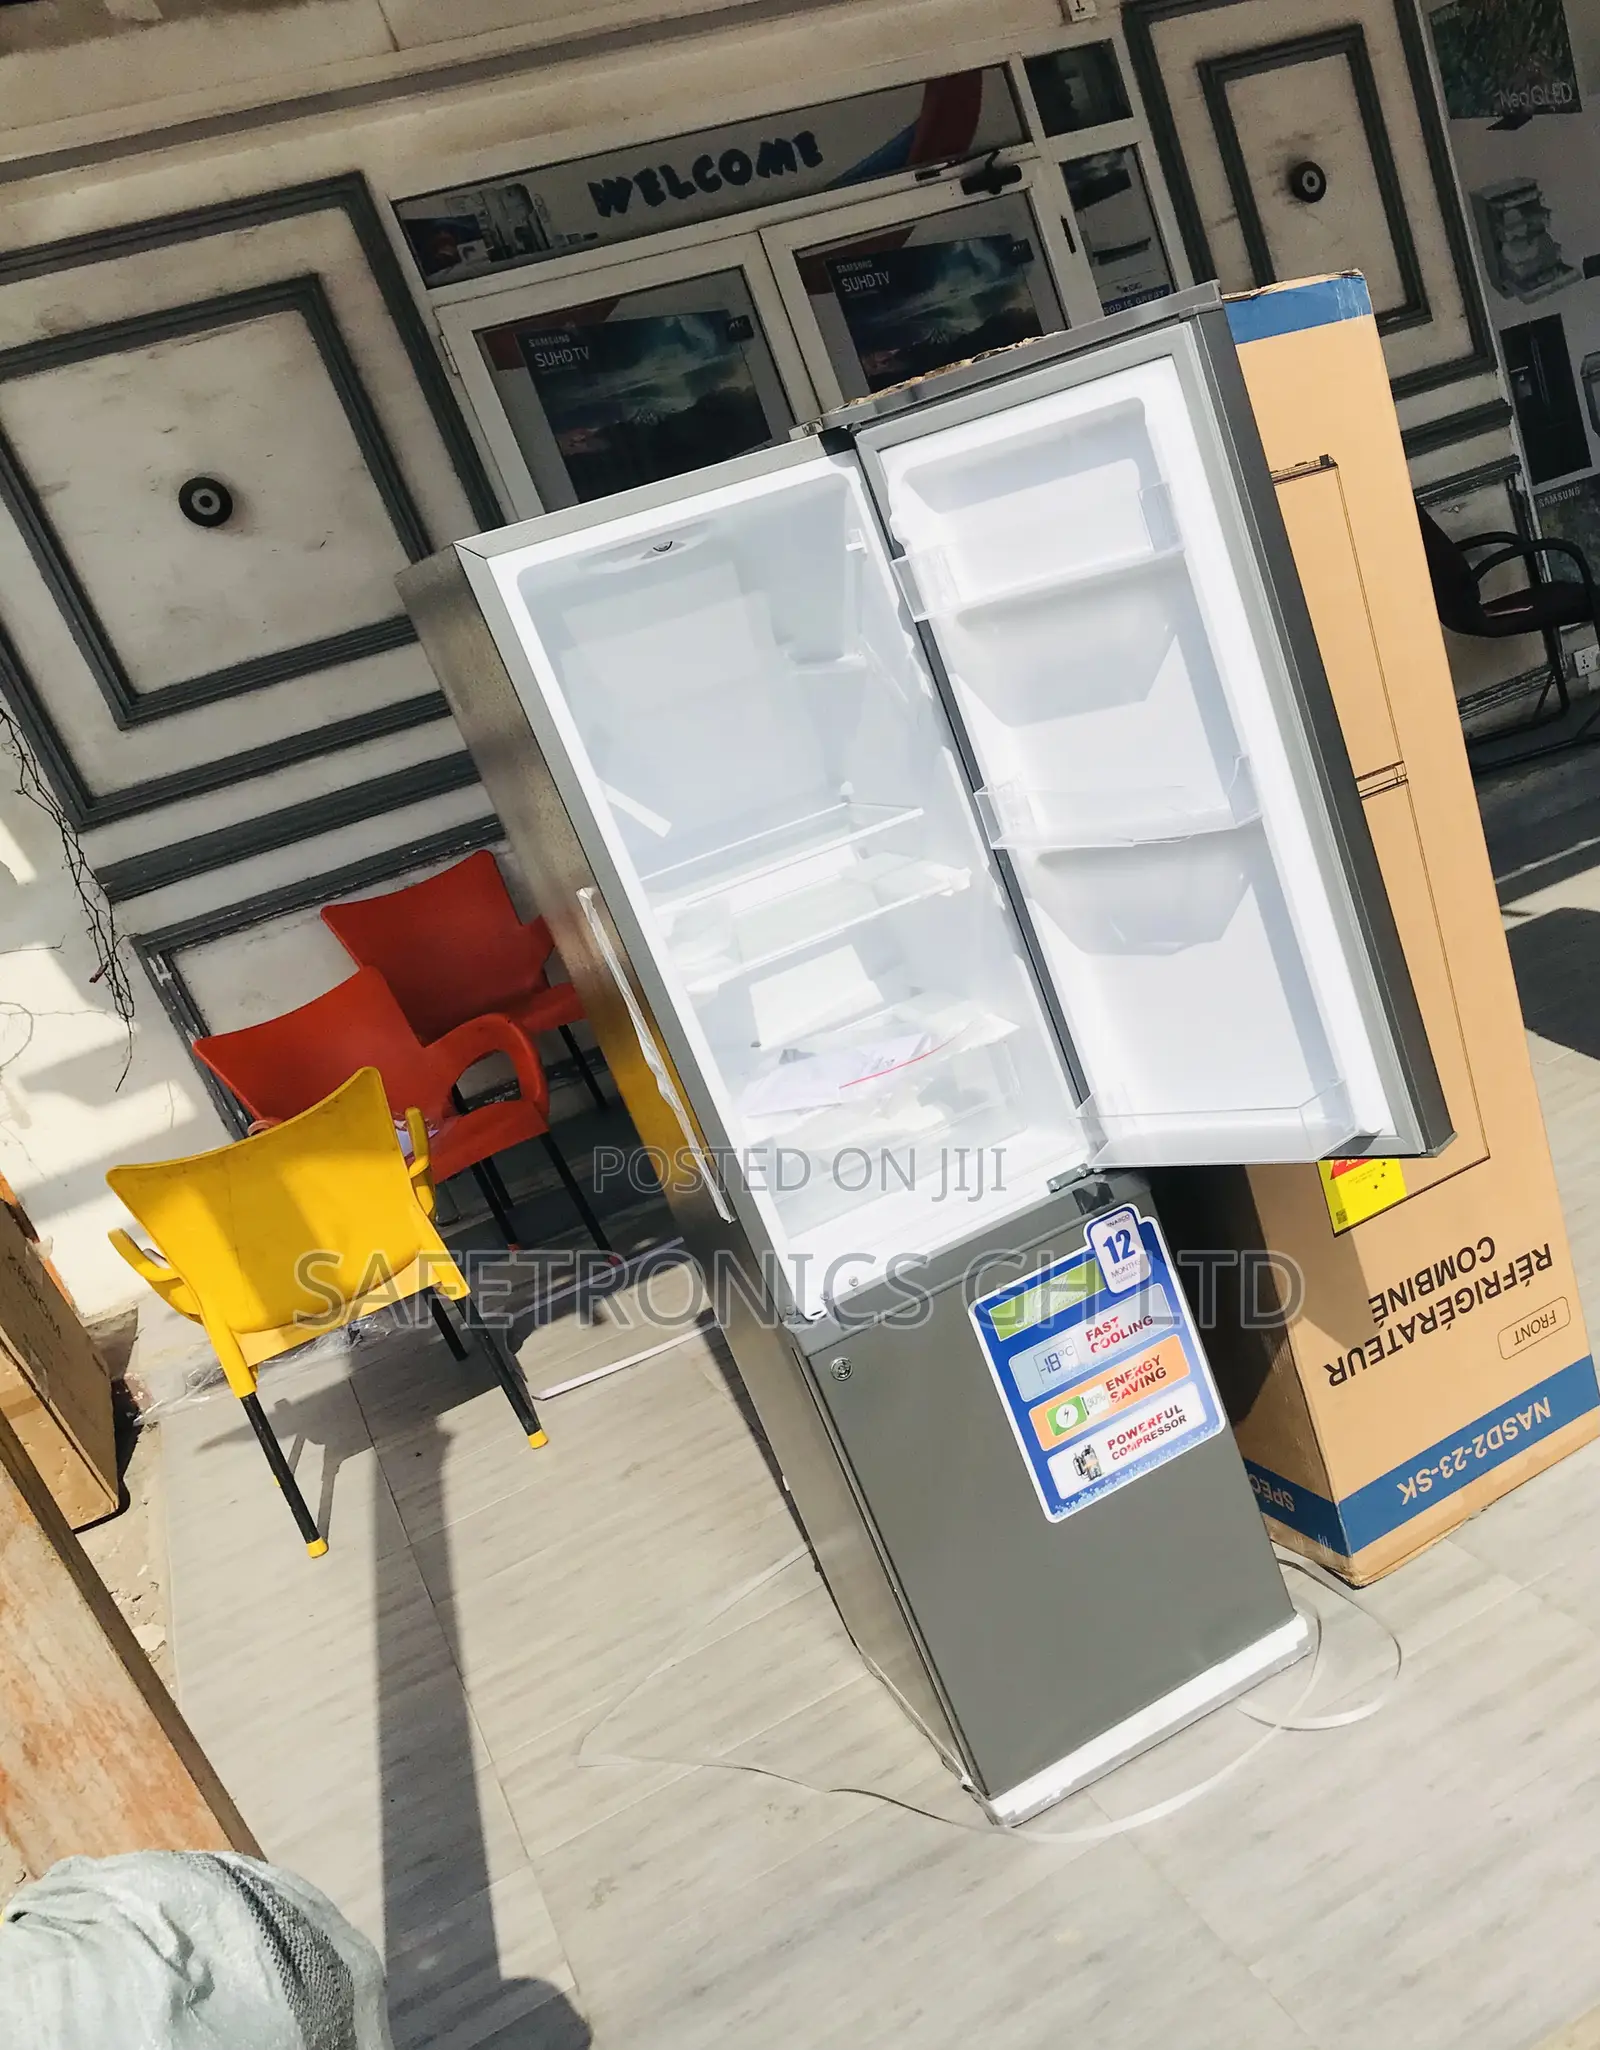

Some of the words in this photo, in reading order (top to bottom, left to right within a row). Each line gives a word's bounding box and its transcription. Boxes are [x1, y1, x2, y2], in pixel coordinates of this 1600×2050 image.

[587, 130, 824, 218] WELCOME
[1538, 486, 1581, 508] SAMSUNG
[1103, 1229, 1136, 1264] 12
[1368, 1236, 1496, 1329] COMBINÉ
[1085, 1315, 1119, 1342] FAST
[1090, 1315, 1154, 1354] COOLING
[1323, 1243, 1553, 1387] RÉFRIGÉRATEUR
[1513, 1309, 1558, 1346] FRONT
[1105, 1354, 1162, 1392] ENERGY
[1109, 1366, 1167, 1404] SAVING
[1107, 1404, 1183, 1450] POWERFUL
[1111, 1414, 1188, 1461] COMPRESSOR
[1397, 1397, 1552, 1506] NASD2-23-SK
